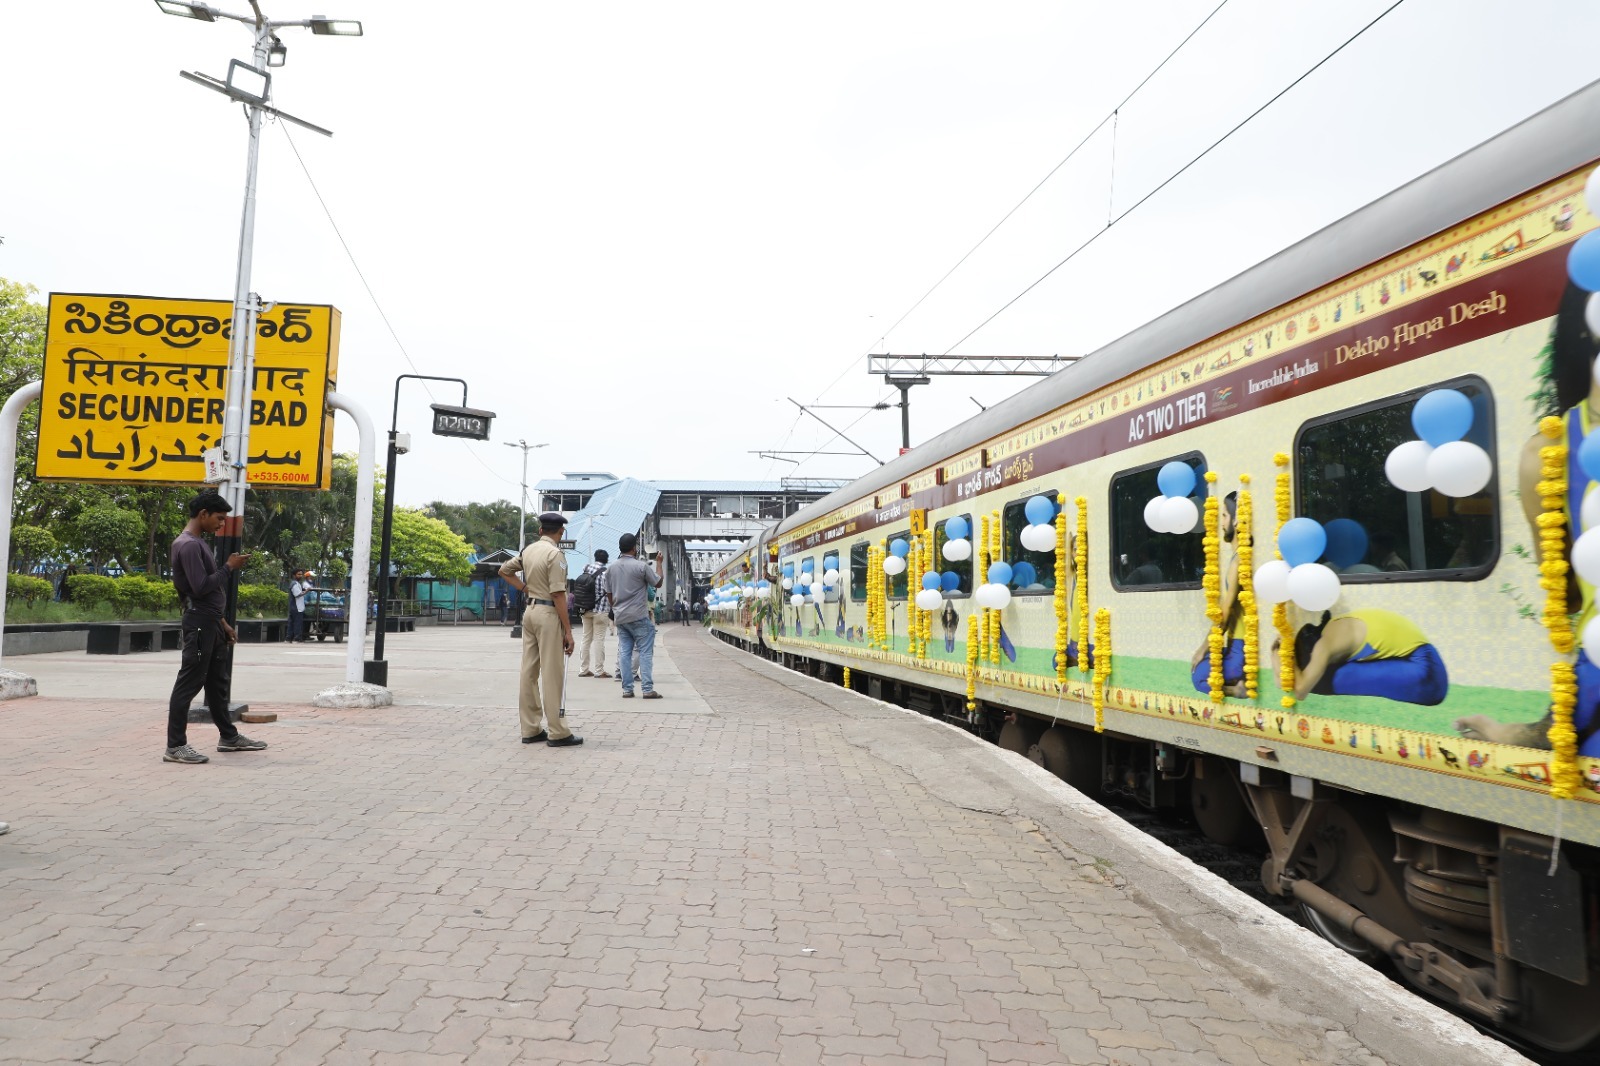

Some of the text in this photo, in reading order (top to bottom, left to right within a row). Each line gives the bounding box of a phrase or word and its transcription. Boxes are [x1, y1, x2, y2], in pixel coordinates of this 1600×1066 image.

[1335, 333, 1390, 365] Dekho
[1449, 290, 1507, 327] Desh
[62, 347, 311, 396] सिकंदरााद
[58, 392, 307, 427] SECUNDERBAD
[1128, 414, 1145, 442] AC
[1146, 403, 1174, 435] TWO
[1176, 391, 1207, 426] TIER
[57, 425, 301, 471] سندرآباد
[913, 510, 920, 520] A
[913, 521, 919, 531] 1
